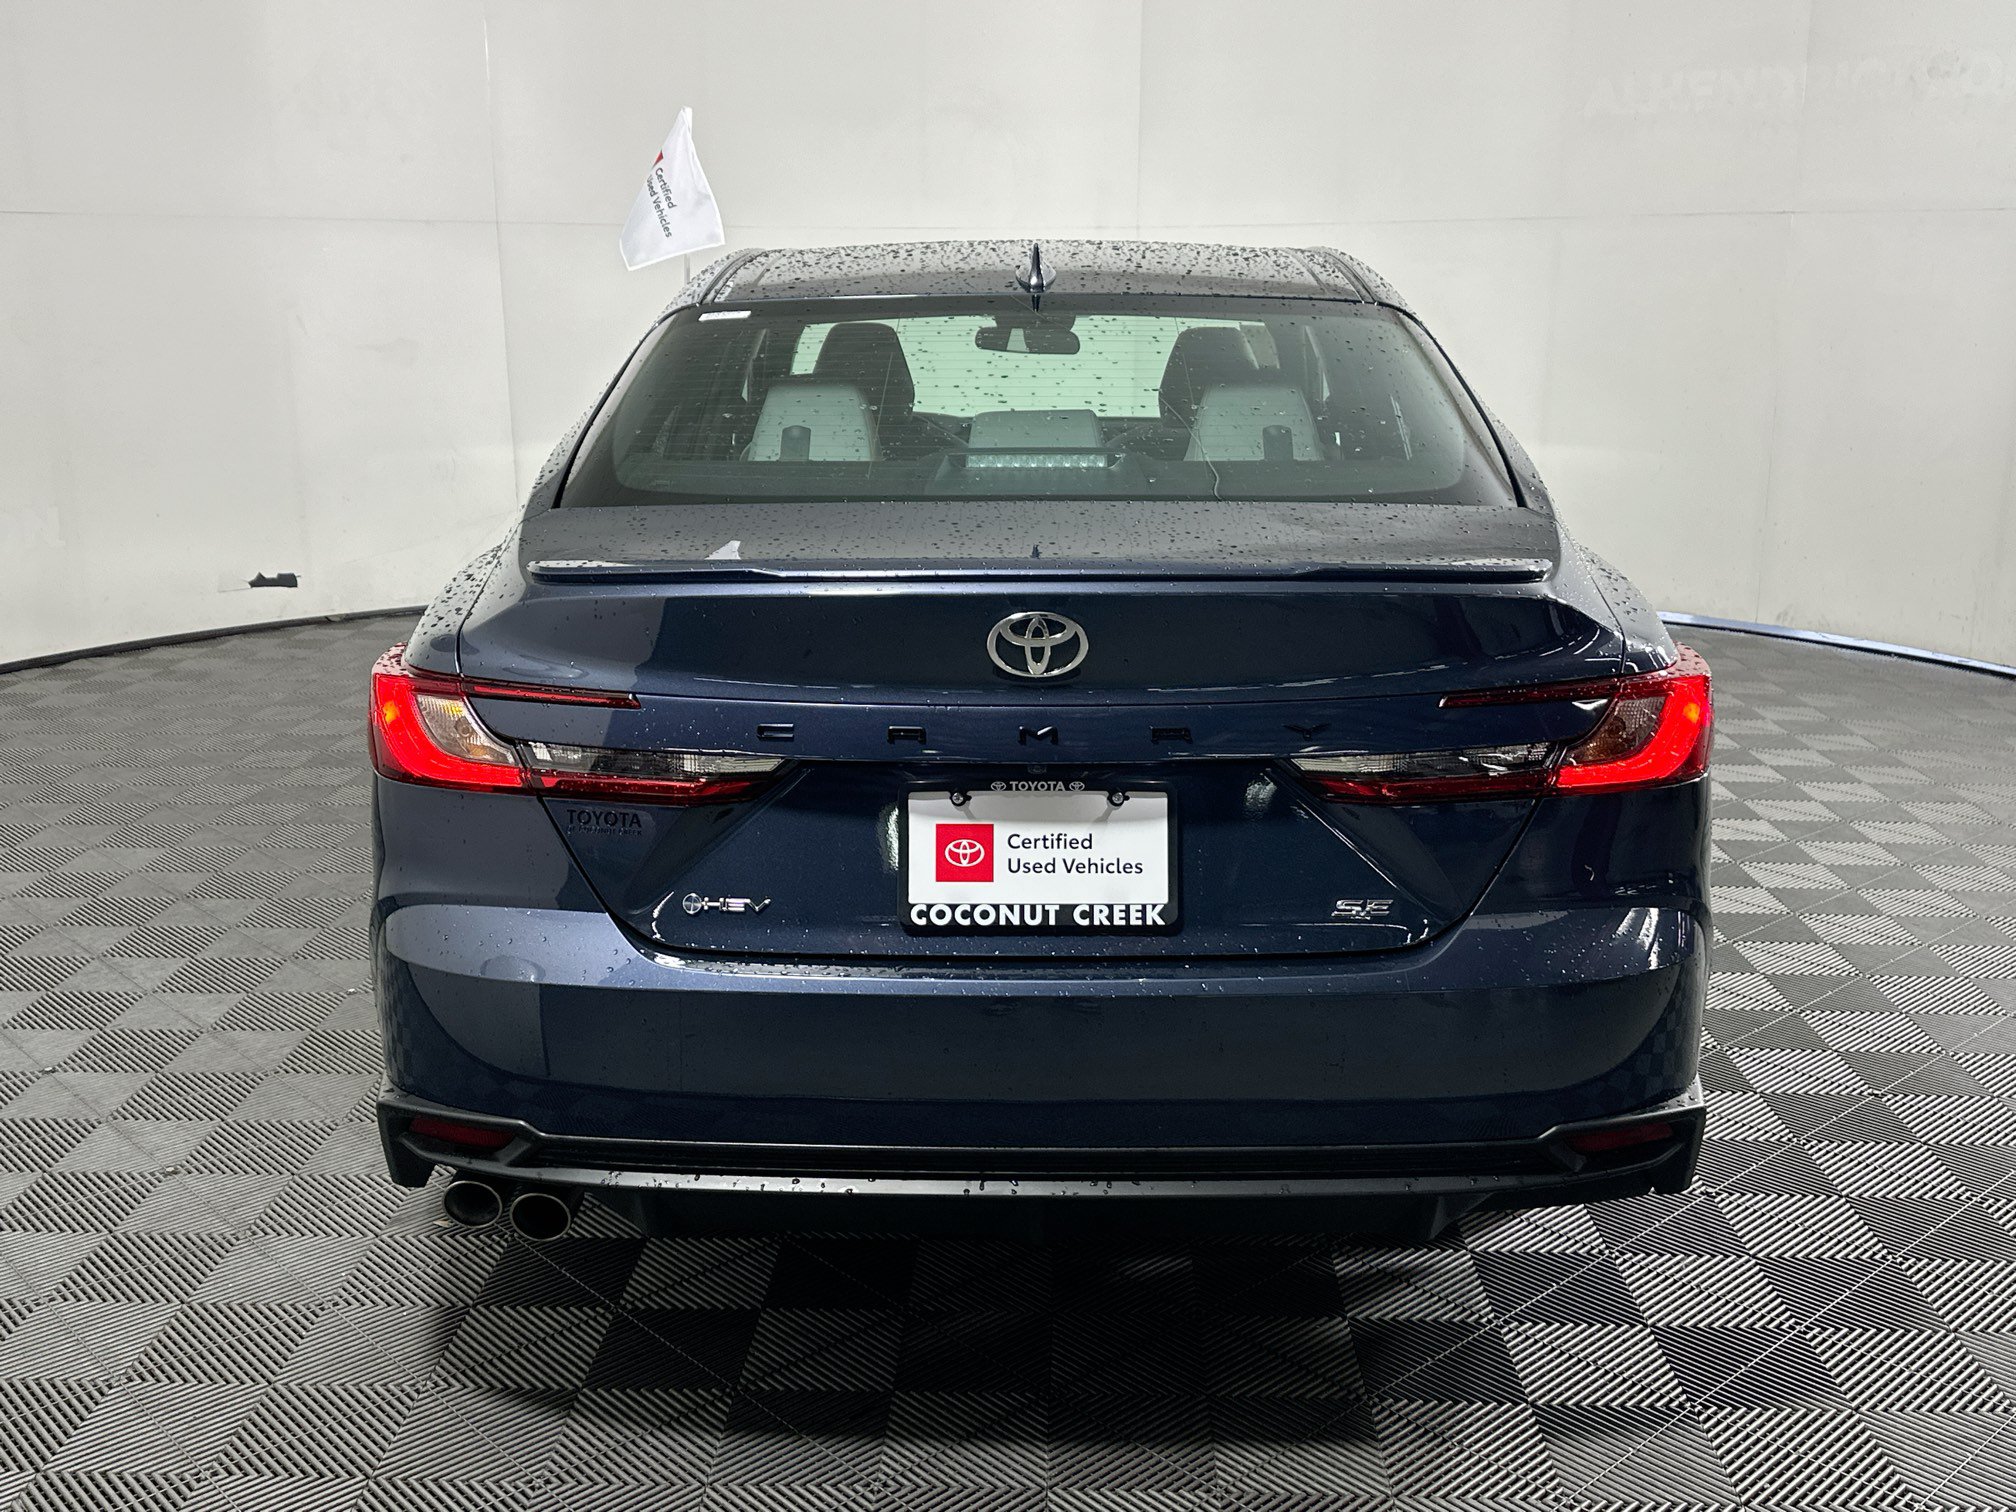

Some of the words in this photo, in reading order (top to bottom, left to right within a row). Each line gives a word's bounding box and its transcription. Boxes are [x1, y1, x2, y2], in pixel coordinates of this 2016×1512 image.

[655, 167, 678, 208] Certified
[653, 196, 672, 238] Vehicles
[1010, 781, 1066, 792] TOYOTA
[567, 809, 642, 828] TOYOTA
[1007, 833, 1093, 850] Certified
[1007, 858, 1056, 874] Used
[1063, 858, 1143, 874] Vehicles
[910, 904, 1060, 926] COCONUT
[1073, 904, 1166, 926] CREEK
[1331, 899, 1393, 917] SE
